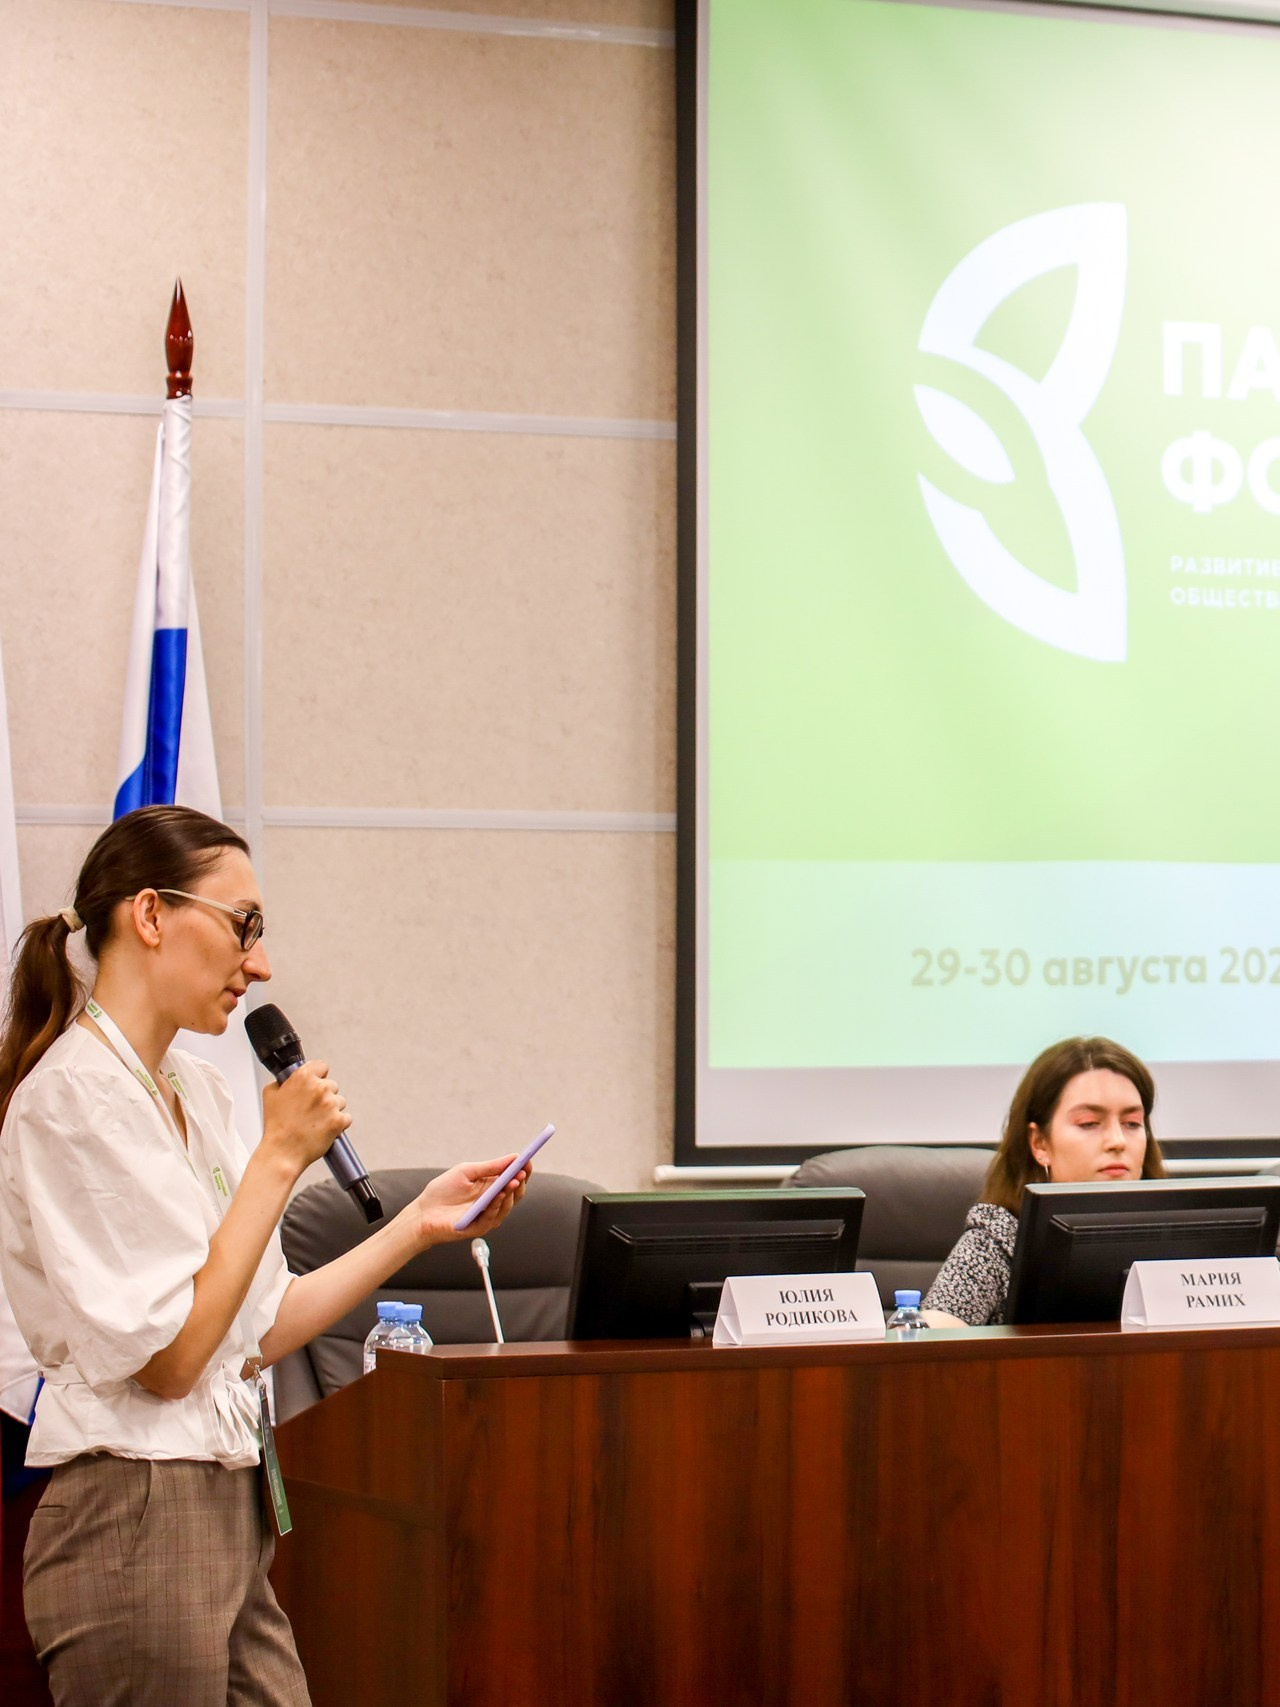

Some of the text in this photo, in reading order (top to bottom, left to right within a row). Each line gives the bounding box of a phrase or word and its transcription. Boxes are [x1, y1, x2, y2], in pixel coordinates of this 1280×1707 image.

[911, 947, 1032, 988] 29-30
[1042, 954, 1209, 995] августа
[1180, 1271, 1242, 1287] МАРИЯ
[779, 1288, 835, 1305] ЮЛИЯ
[1186, 1293, 1246, 1309] РАМИХ
[765, 1308, 859, 1328] РОДИКОВА
